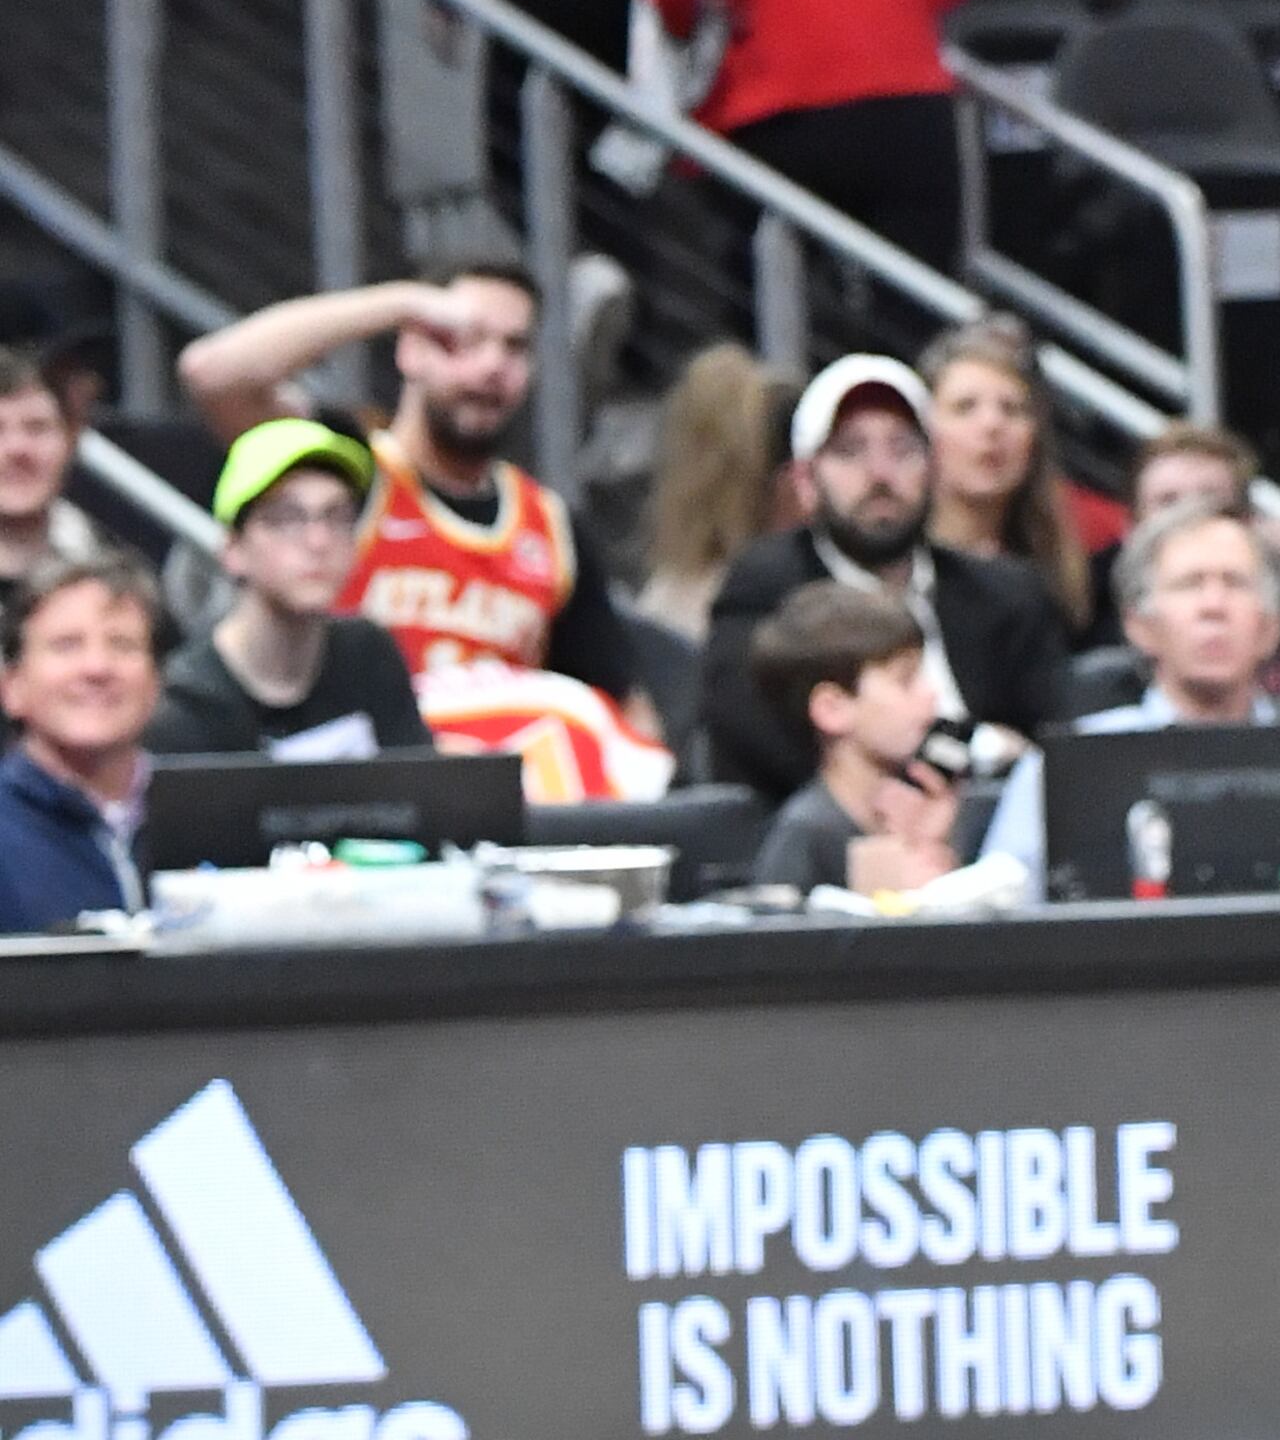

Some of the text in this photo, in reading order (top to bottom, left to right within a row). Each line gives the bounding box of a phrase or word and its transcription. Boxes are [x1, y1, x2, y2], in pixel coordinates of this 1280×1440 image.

[622, 1120, 1180, 1280] IMPOSSIBLE
[637, 1295, 738, 1435] IS
[746, 1275, 1164, 1428] NOTHING
